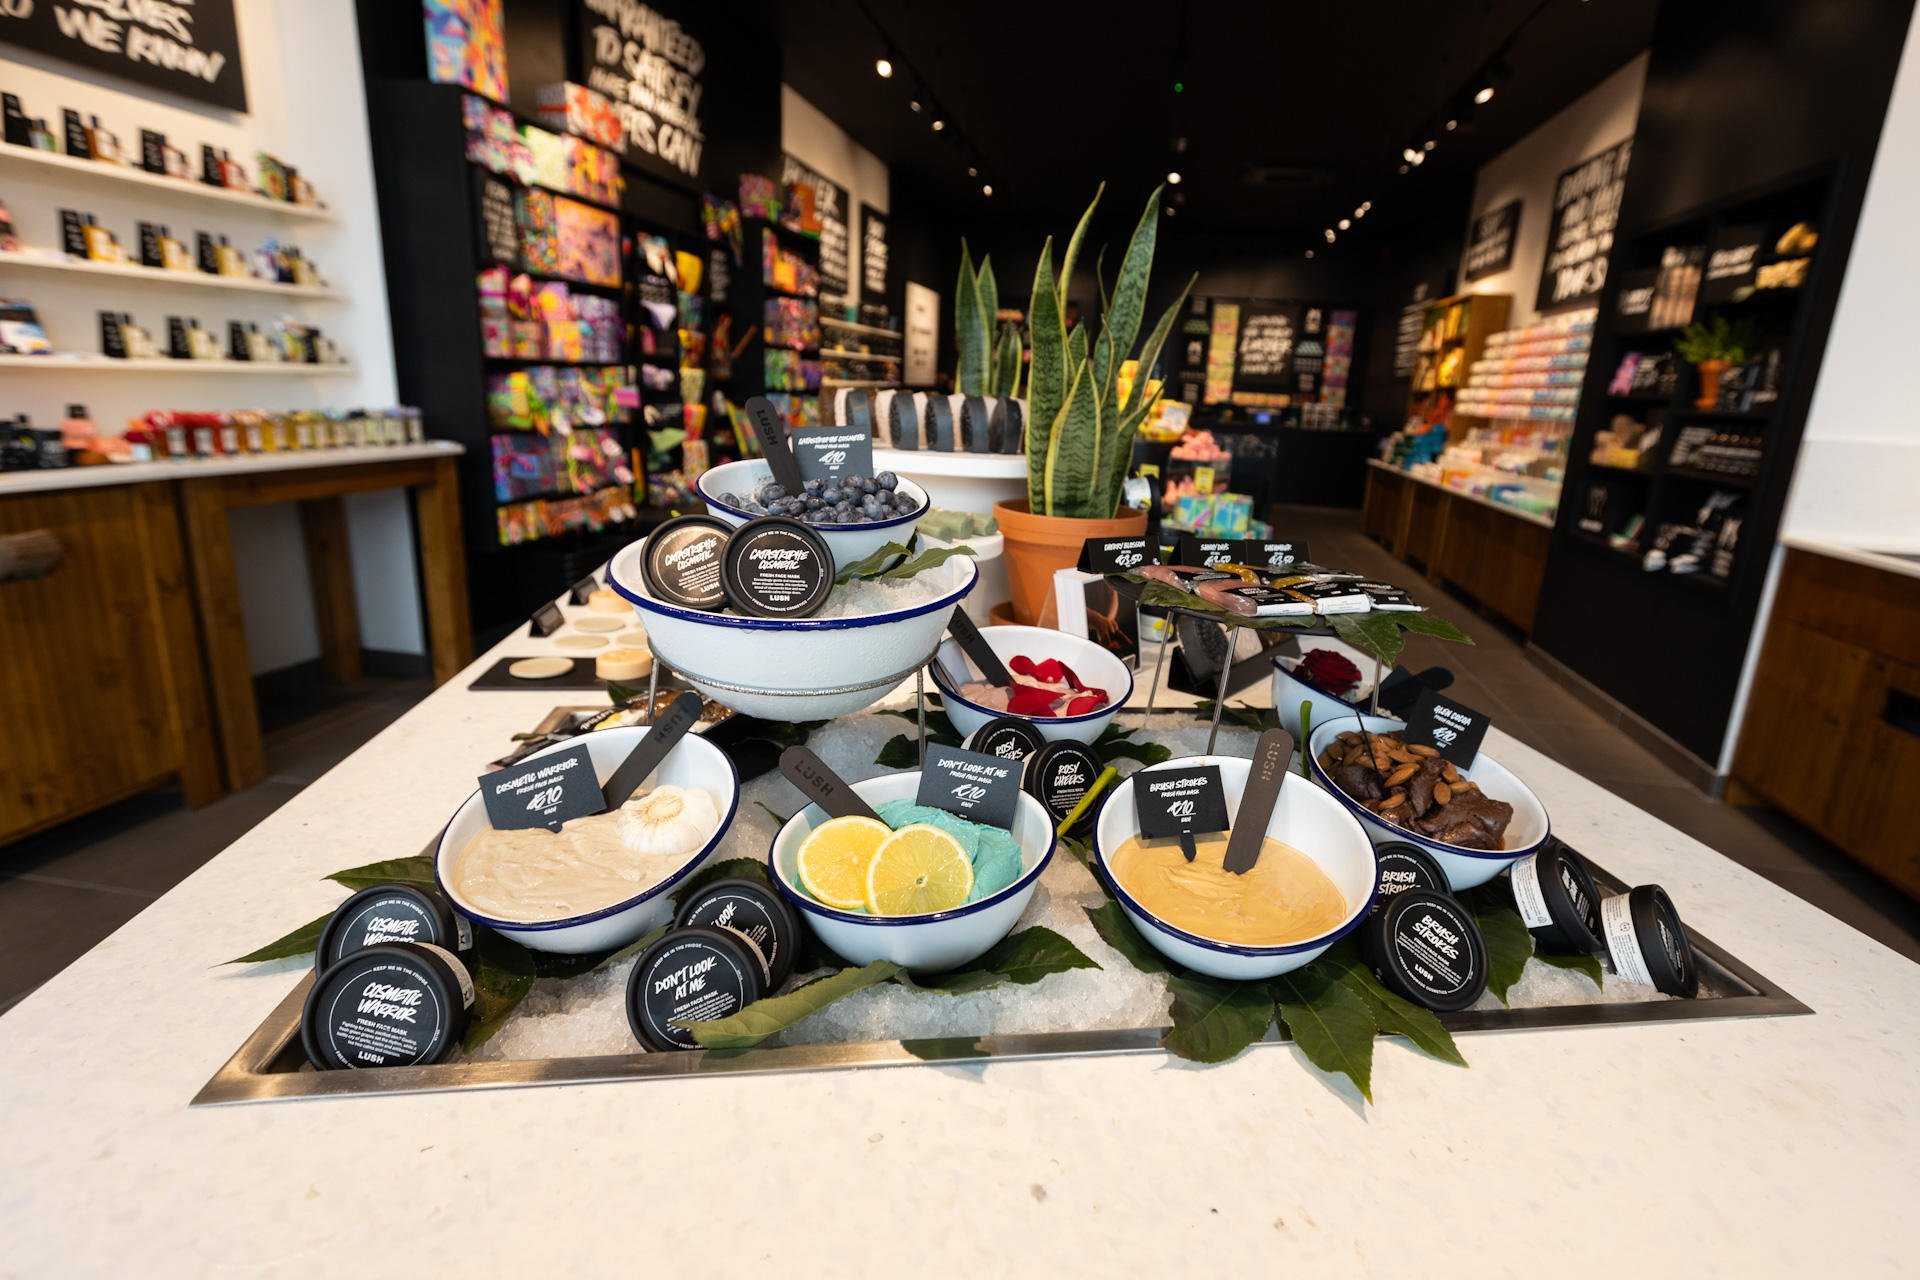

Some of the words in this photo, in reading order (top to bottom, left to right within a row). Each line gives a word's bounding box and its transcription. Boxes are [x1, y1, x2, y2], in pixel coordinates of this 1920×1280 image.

[54, 5, 124, 53] WE
[756, 409, 778, 446] LUSH
[665, 537, 717, 567] CATASTROPHE
[677, 550, 714, 571] COSMETIC
[749, 548, 809, 561] CATASTROPHE
[758, 560, 800, 570] COSMETIC
[700, 582, 720, 593] LUSH
[653, 703, 690, 745] LUSH
[1433, 704, 1452, 717] GLEN
[1450, 712, 1472, 726] COCOA
[995, 737, 1015, 757] ROSY
[937, 758, 965, 770] DON'T
[963, 762, 984, 774] LOOK
[982, 766, 997, 776] AT
[993, 768, 1009, 778] ME
[1058, 761, 1080, 775] ROSY
[1260, 742, 1280, 781] LUSH
[495, 773, 536, 794] COSMETIC
[537, 758, 578, 778] WARRIOR
[794, 760, 834, 797] LUSH
[1053, 773, 1085, 787] CHEEKS
[1149, 780, 1175, 793] BRUSH
[1175, 776, 1208, 789] STROKES
[1382, 870, 1416, 883] BRUSH
[410, 903, 424, 915] FRIDGE
[367, 916, 420, 935] COSMETIC
[1421, 914, 1459, 945] BRUSH
[1412, 922, 1459, 960] STROKES
[654, 956, 664, 968] KEEP
[402, 967, 413, 975] THE
[412, 972, 428, 986] FRIDGE
[654, 965, 689, 994] DON'T
[689, 956, 717, 979] LOOK
[1414, 963, 1434, 982] LUSH
[362, 981, 423, 1006] COSMETIC
[675, 980, 689, 1001] AT
[689, 974, 706, 994] ME
[357, 998, 418, 1024] WARRIOR
[674, 1002, 690, 1014] FRESH
[690, 996, 703, 1006] FACE
[703, 990, 718, 1001] MASK
[356, 1017, 376, 1028] FRESH
[376, 1023, 391, 1031] FACE
[390, 1026, 408, 1036] MASK
[335, 1050, 348, 1064] FRESH
[357, 1050, 384, 1064] LUSH
